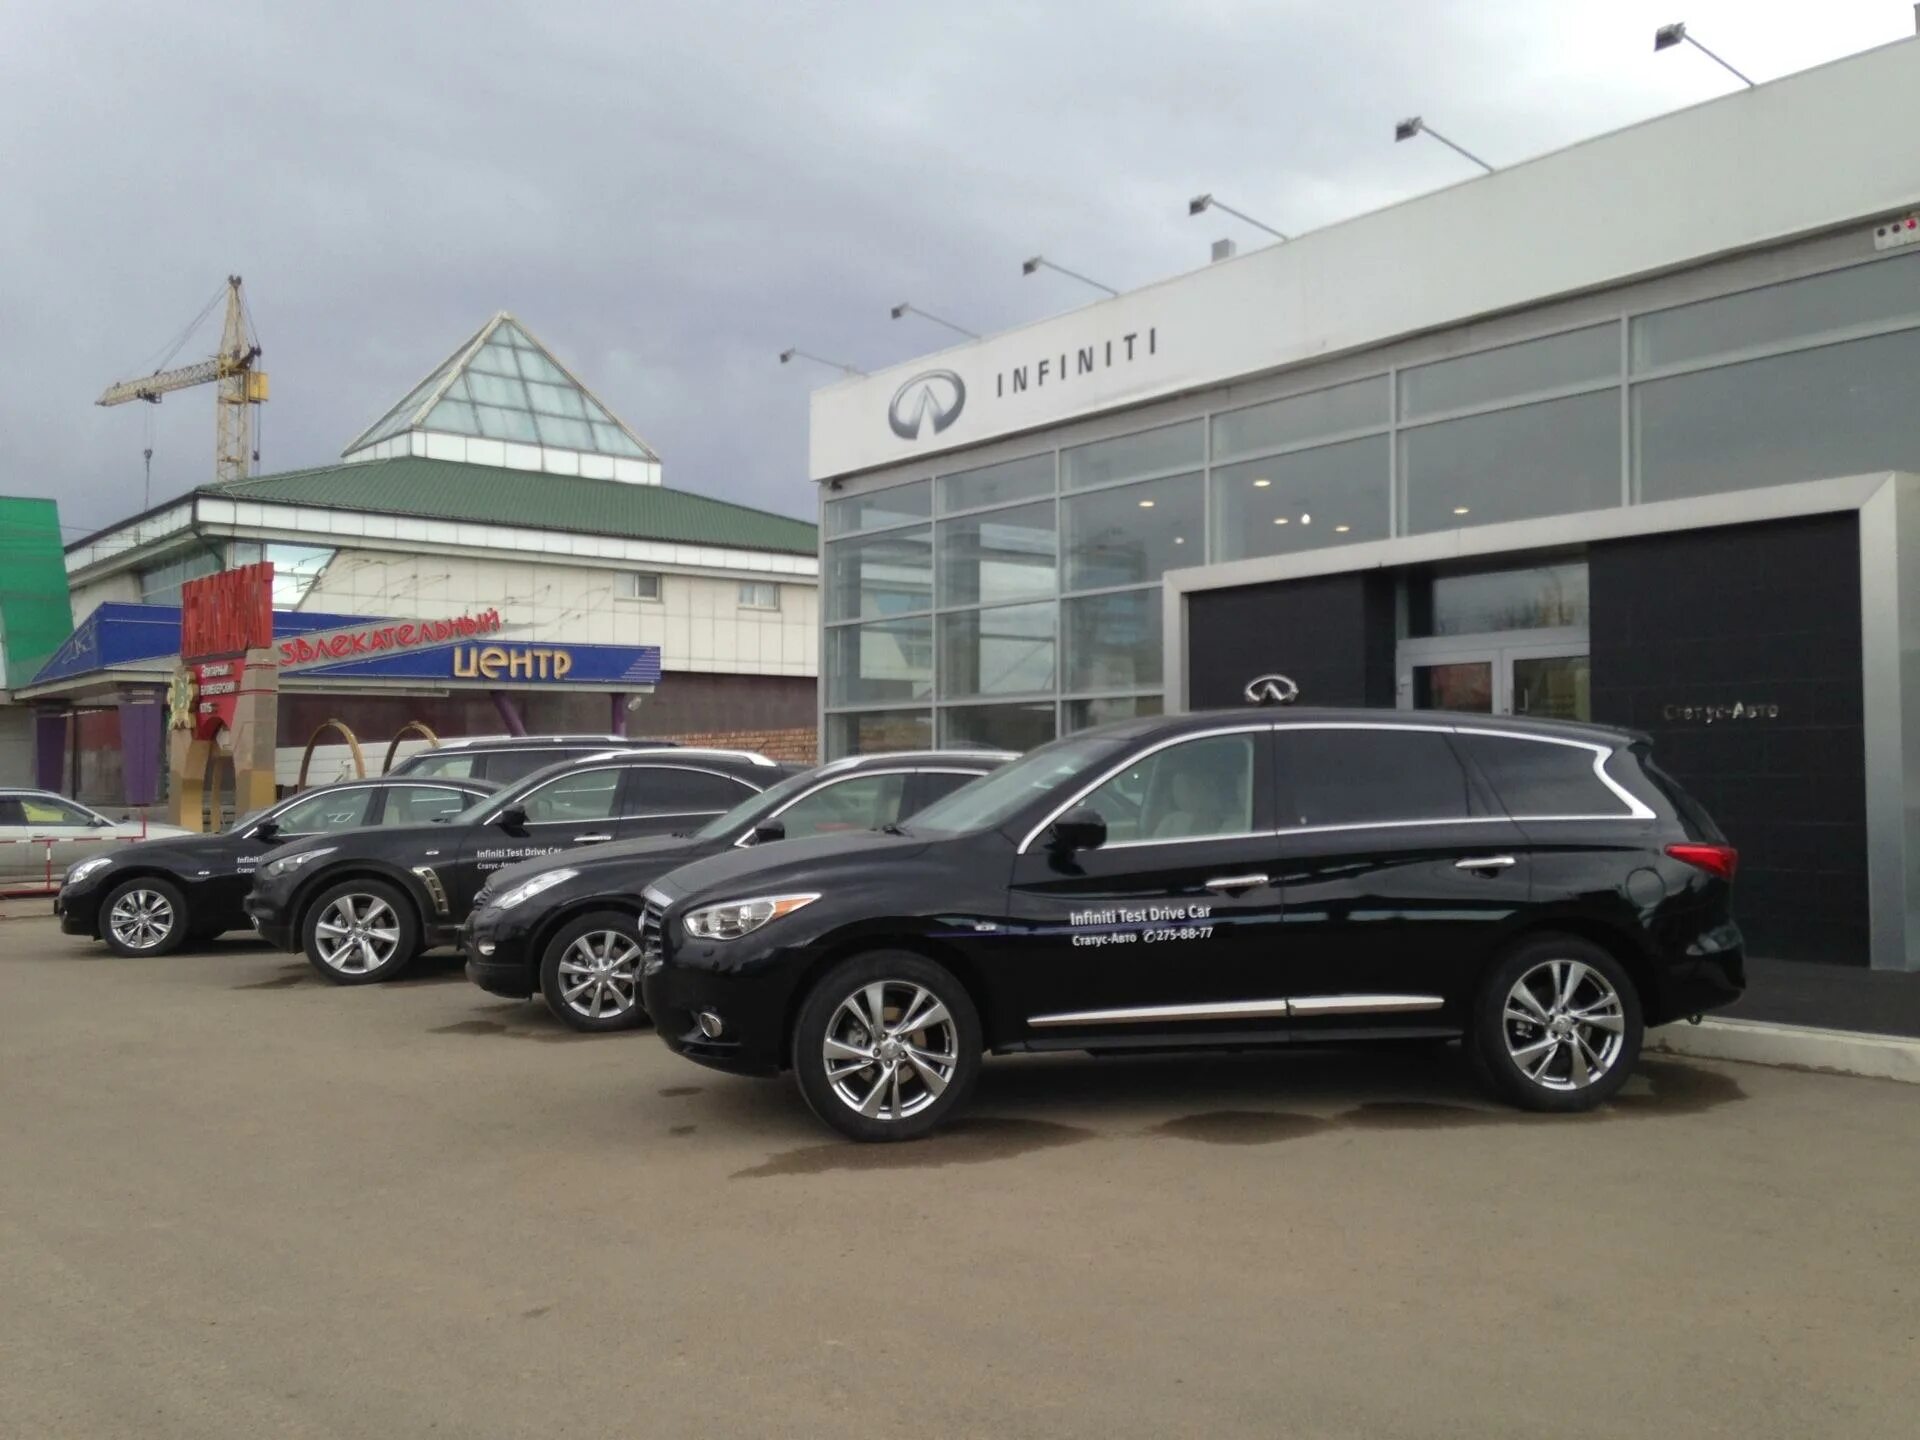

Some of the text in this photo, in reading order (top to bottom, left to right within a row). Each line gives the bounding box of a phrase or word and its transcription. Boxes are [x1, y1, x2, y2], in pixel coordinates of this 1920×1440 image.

[997, 327, 1155, 398] INFINITI
[507, 848, 523, 857] Test
[525, 847, 546, 856] Drive
[1070, 904, 1212, 926] Infiniti Test Drive Car
[1072, 927, 1213, 947] Статус-Авто 275-88-77
